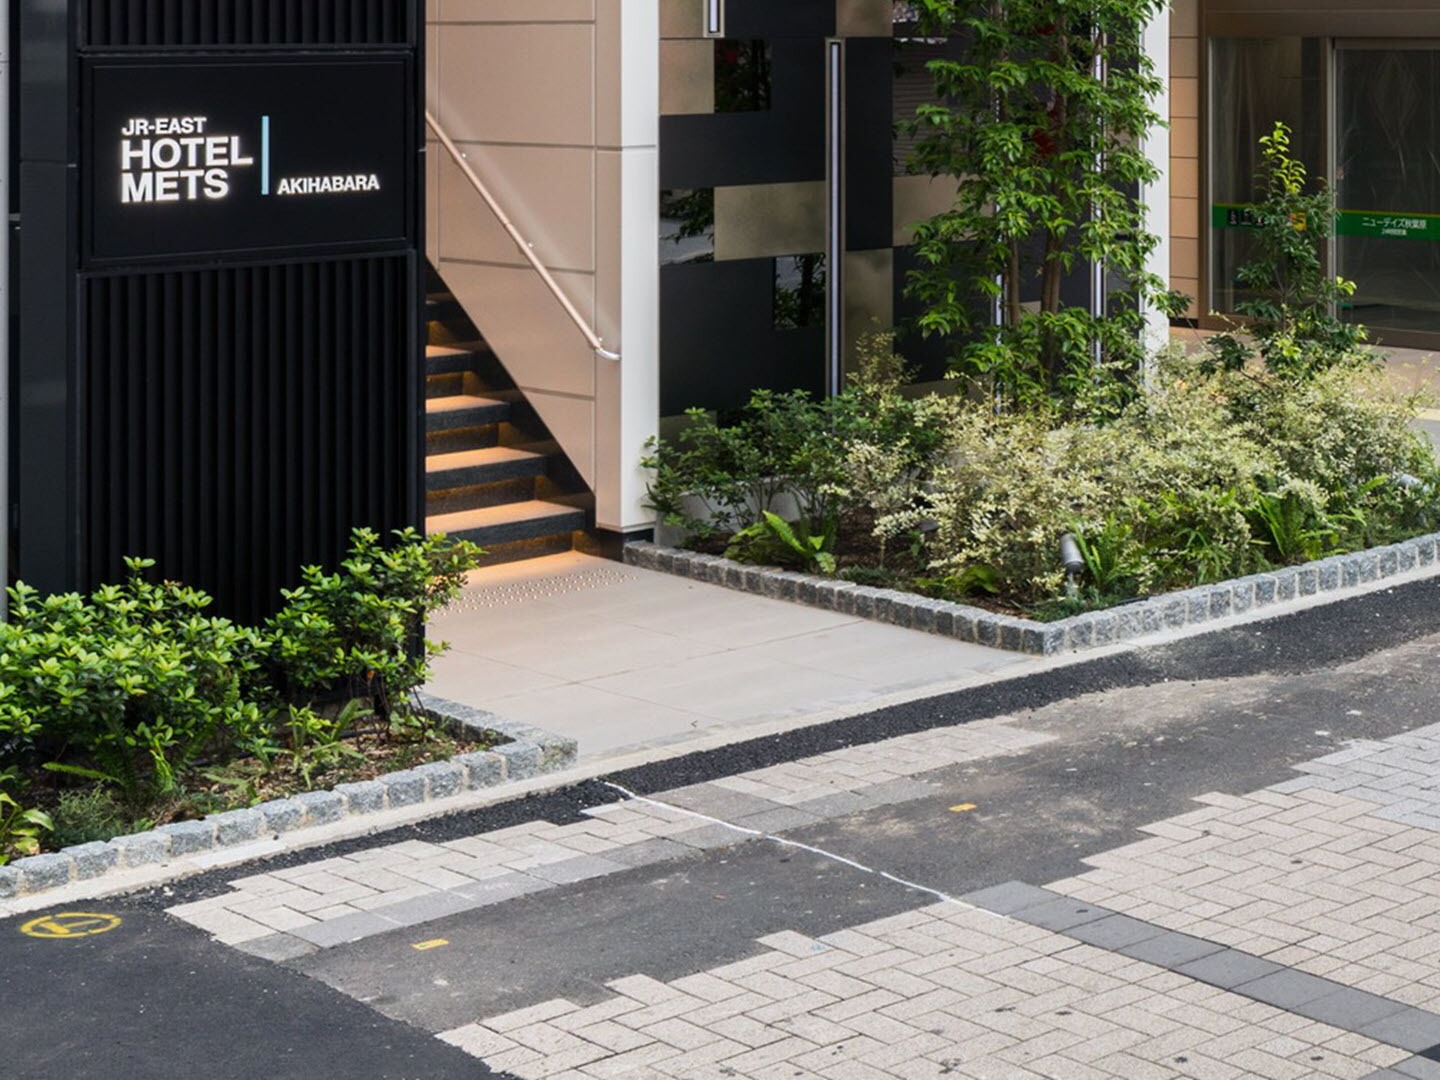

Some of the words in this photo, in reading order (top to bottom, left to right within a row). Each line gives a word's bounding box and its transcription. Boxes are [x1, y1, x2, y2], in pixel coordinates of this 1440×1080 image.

[122, 117, 207, 136] JR-EAST
[121, 136, 253, 170] HOTEL
[121, 168, 229, 203] METS
[277, 174, 380, 195] AKIHABARA
